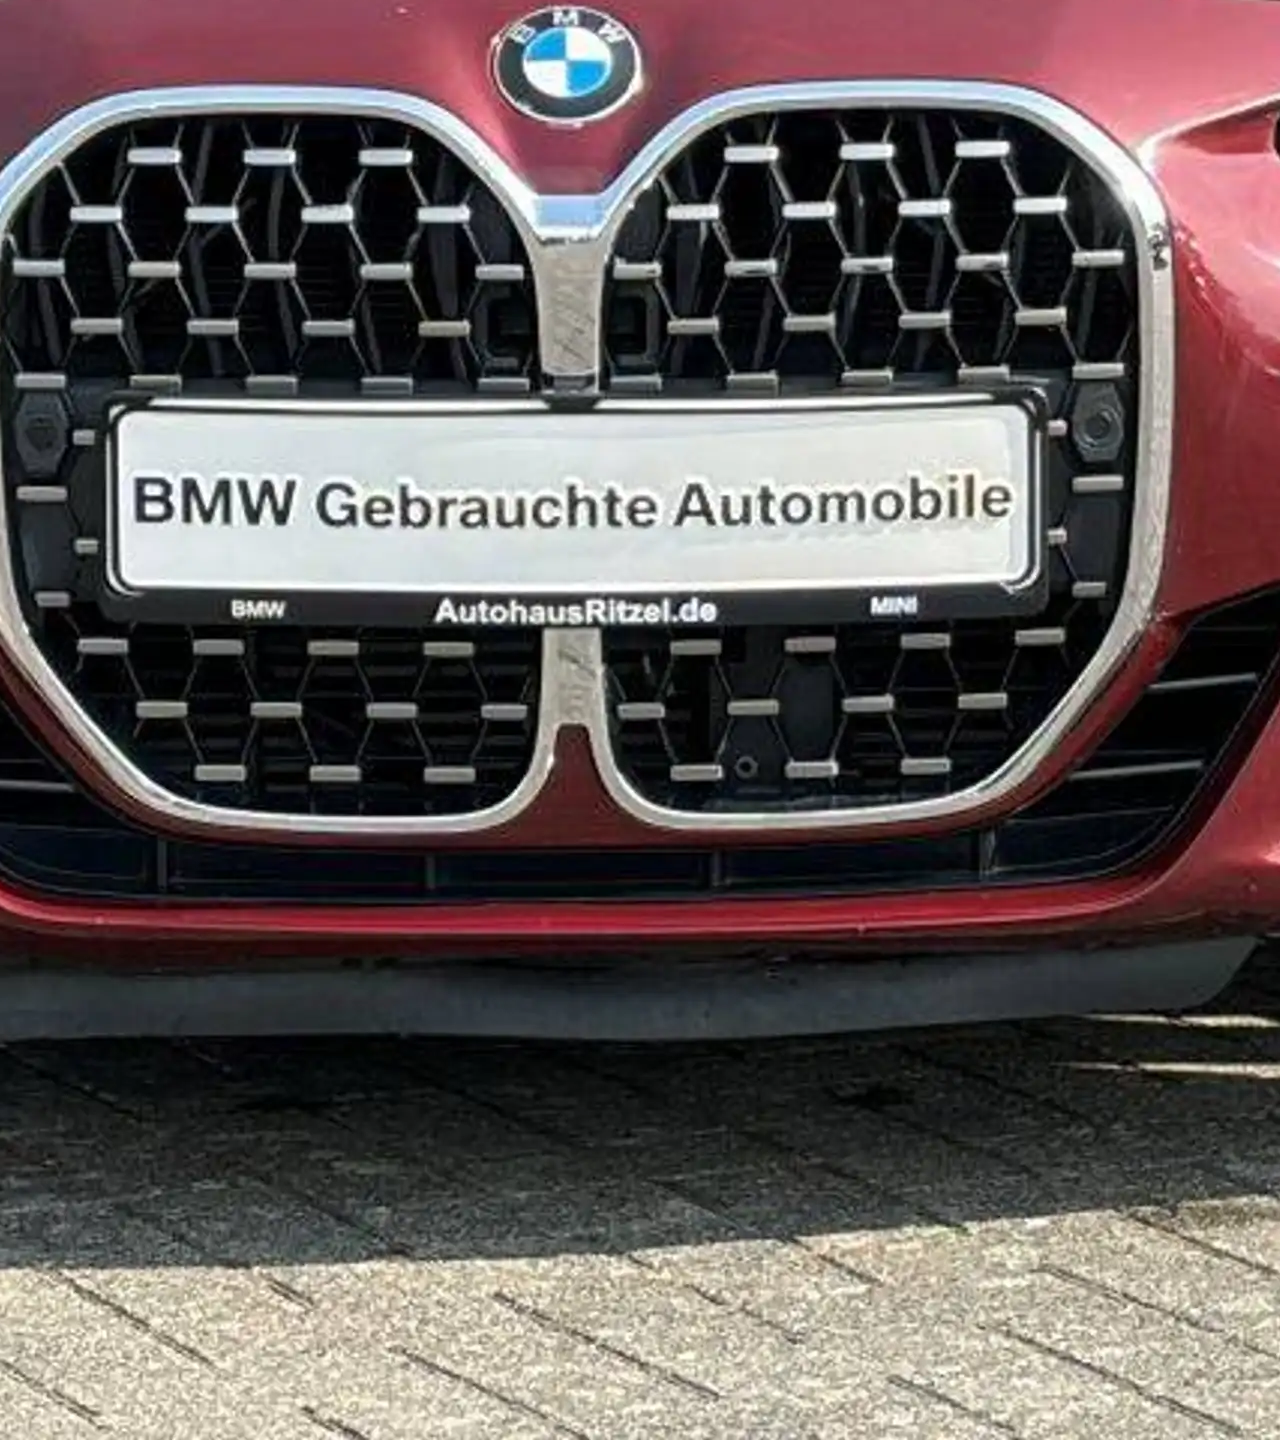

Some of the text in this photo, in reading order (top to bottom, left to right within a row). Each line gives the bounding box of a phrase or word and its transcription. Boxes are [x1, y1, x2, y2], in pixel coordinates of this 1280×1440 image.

[506, 10, 628, 45] BMW
[132, 473, 1014, 529] BMW Gebrauchte Automobile
[230, 595, 919, 625] BMW AutohausRitzel.de MINI
